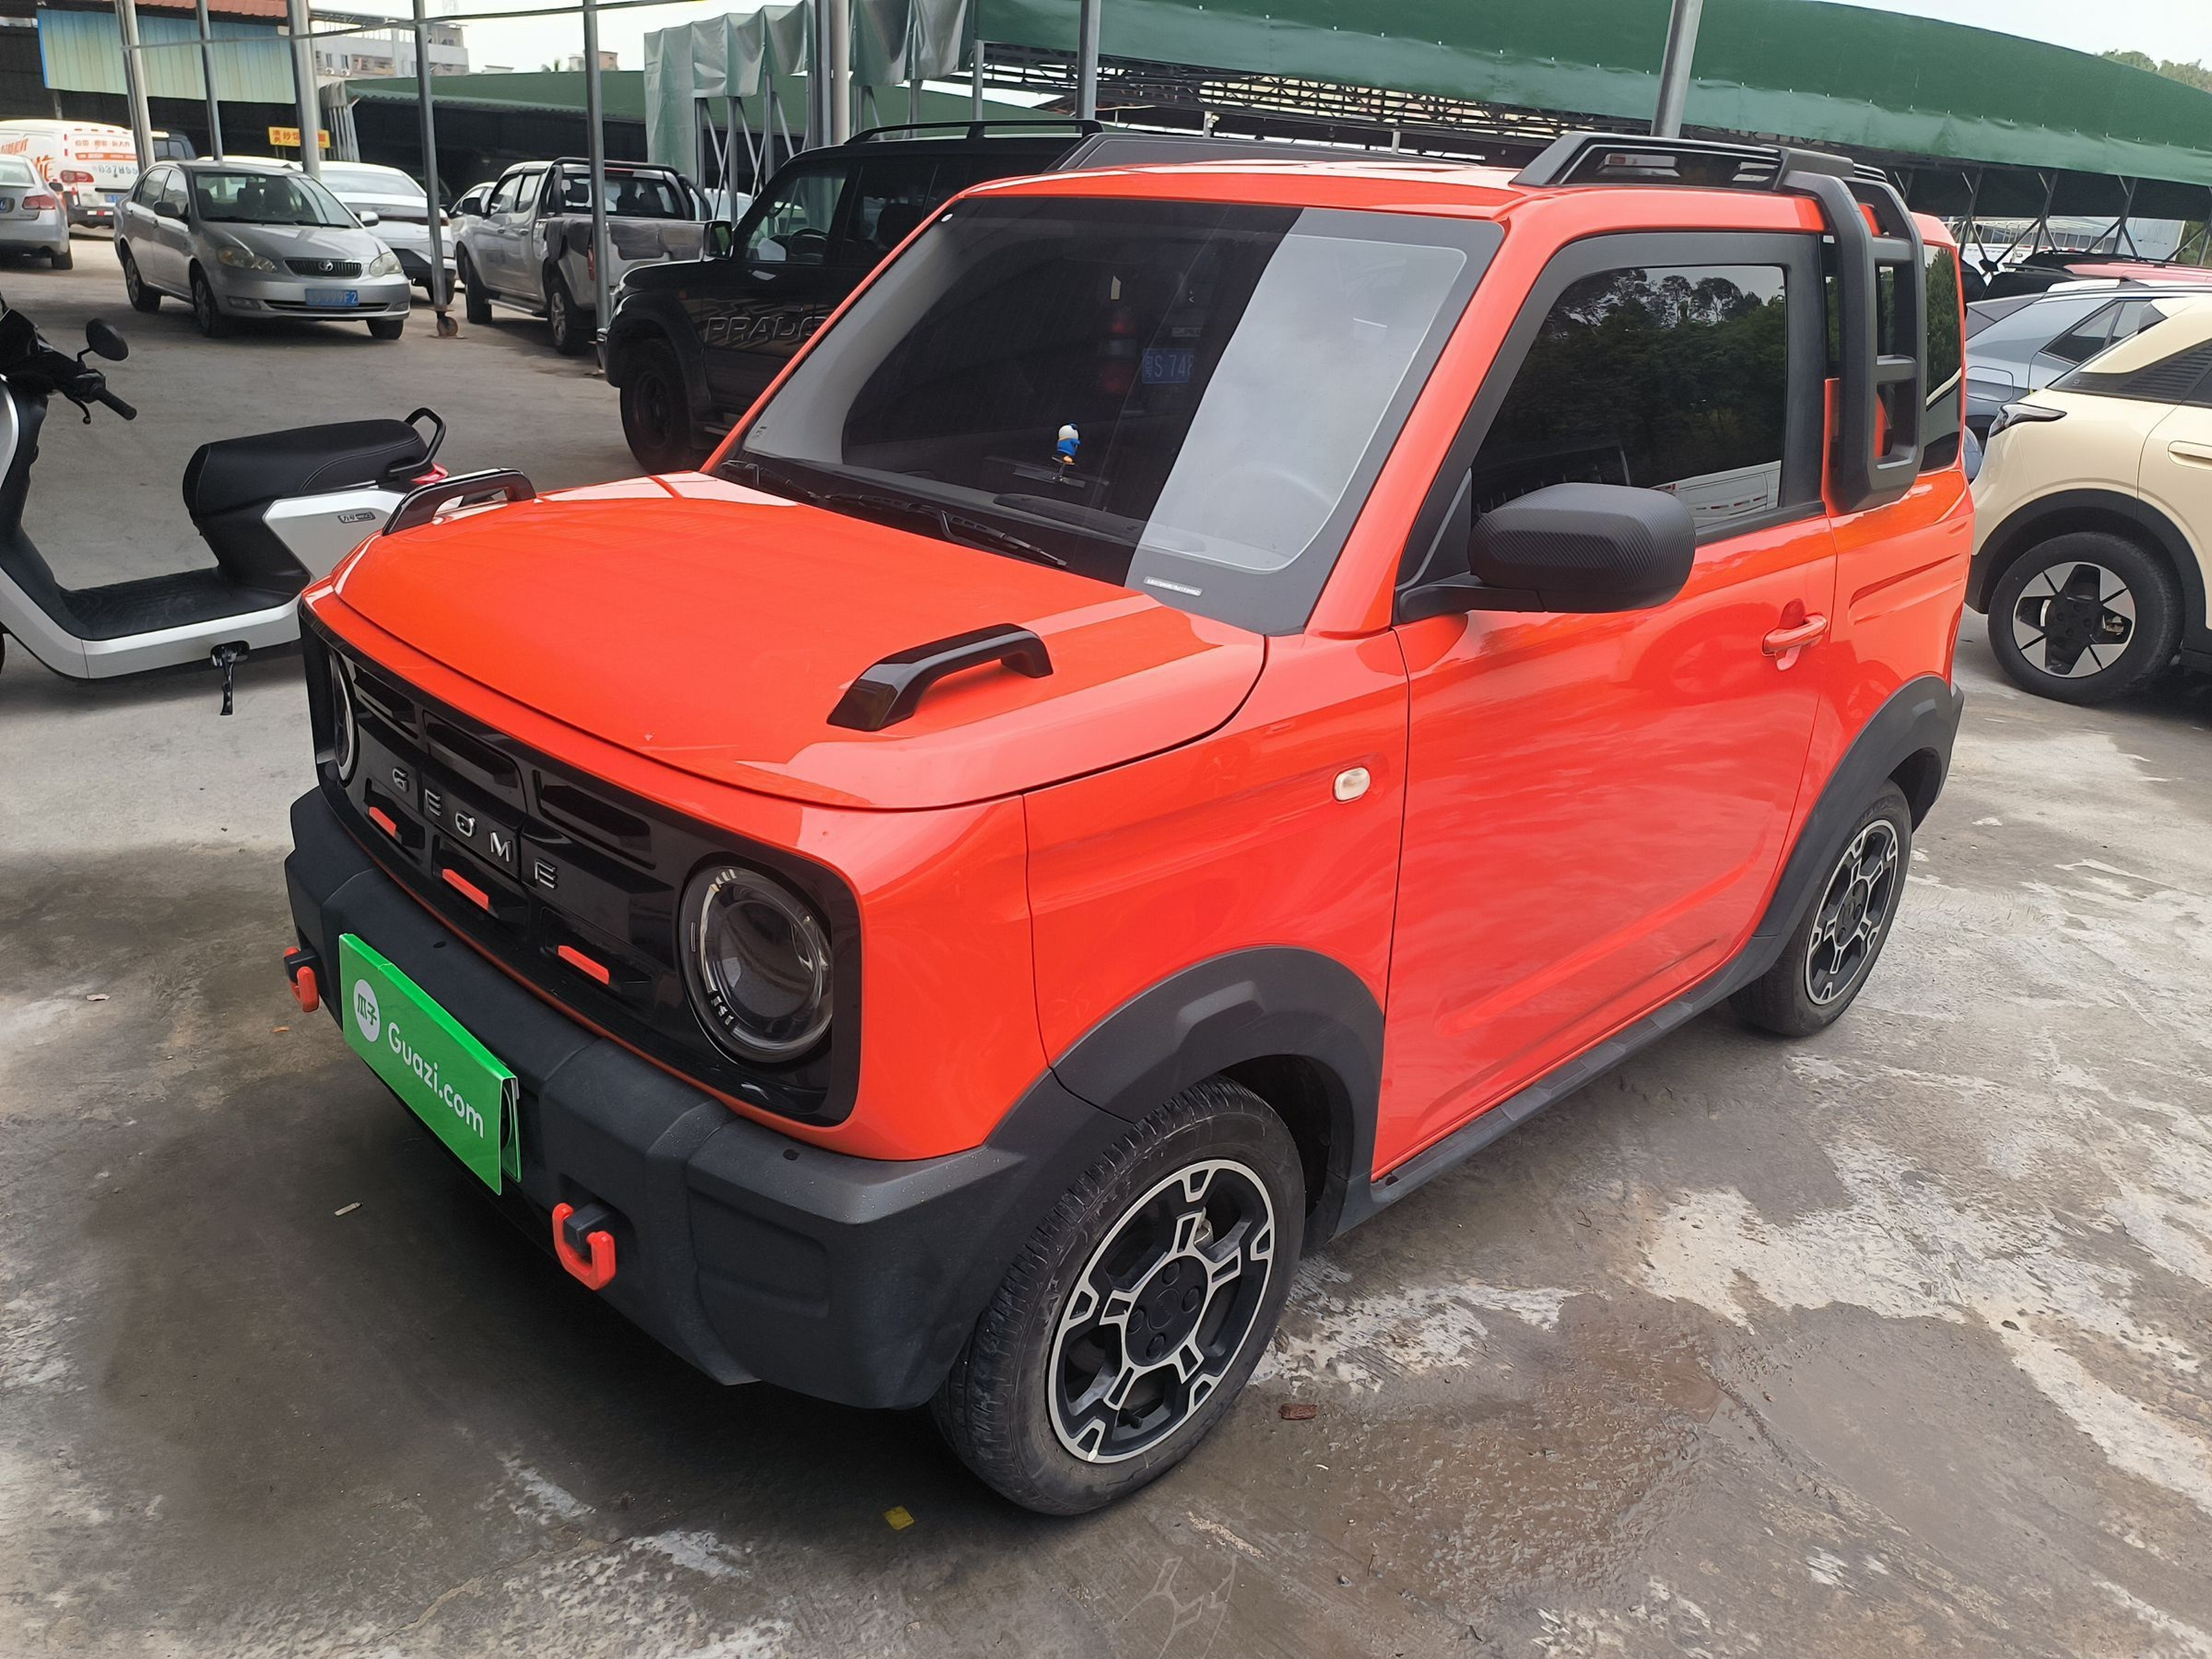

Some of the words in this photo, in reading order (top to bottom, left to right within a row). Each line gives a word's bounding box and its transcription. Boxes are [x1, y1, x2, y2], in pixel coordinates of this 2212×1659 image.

[392, 767, 559, 889] GEOME
[357, 993, 377, 1025] 瓜子
[388, 1022, 484, 1139] Guazi.com
